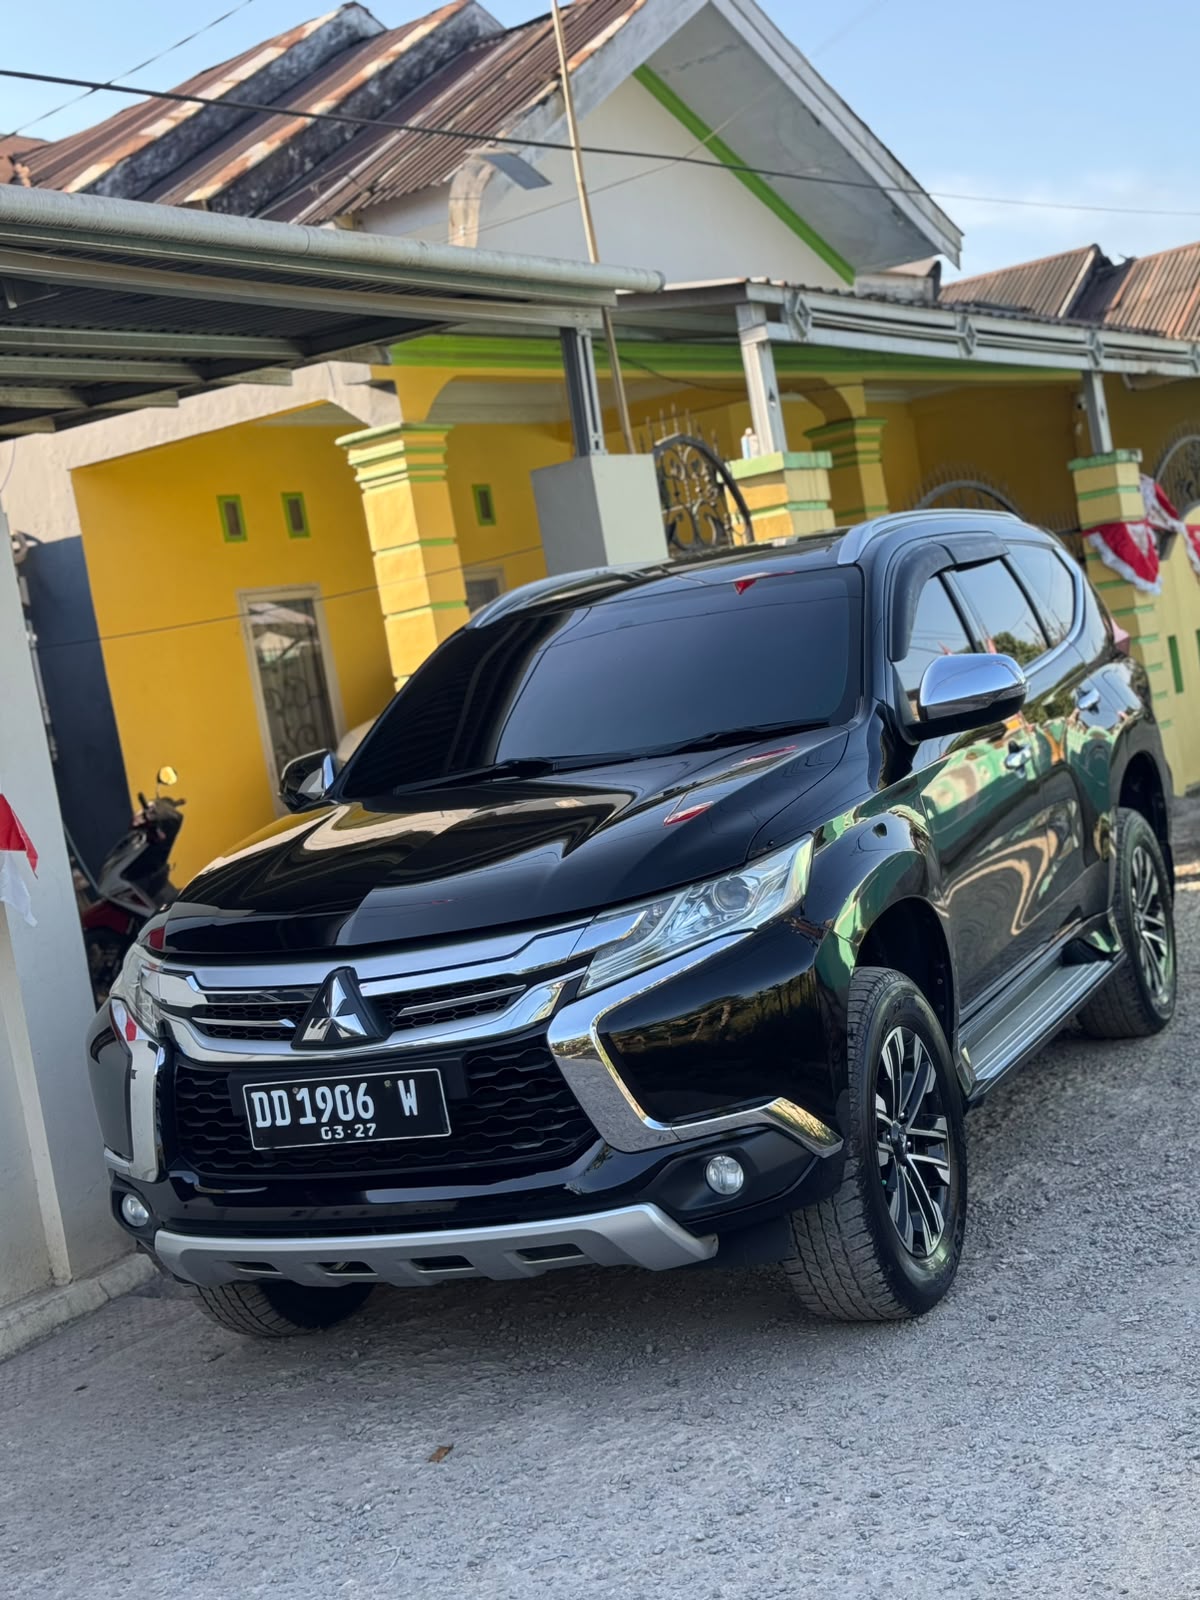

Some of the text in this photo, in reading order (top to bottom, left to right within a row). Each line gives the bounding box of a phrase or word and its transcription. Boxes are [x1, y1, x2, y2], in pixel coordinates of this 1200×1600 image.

[251, 1079, 418, 1128] DD 1906 W
